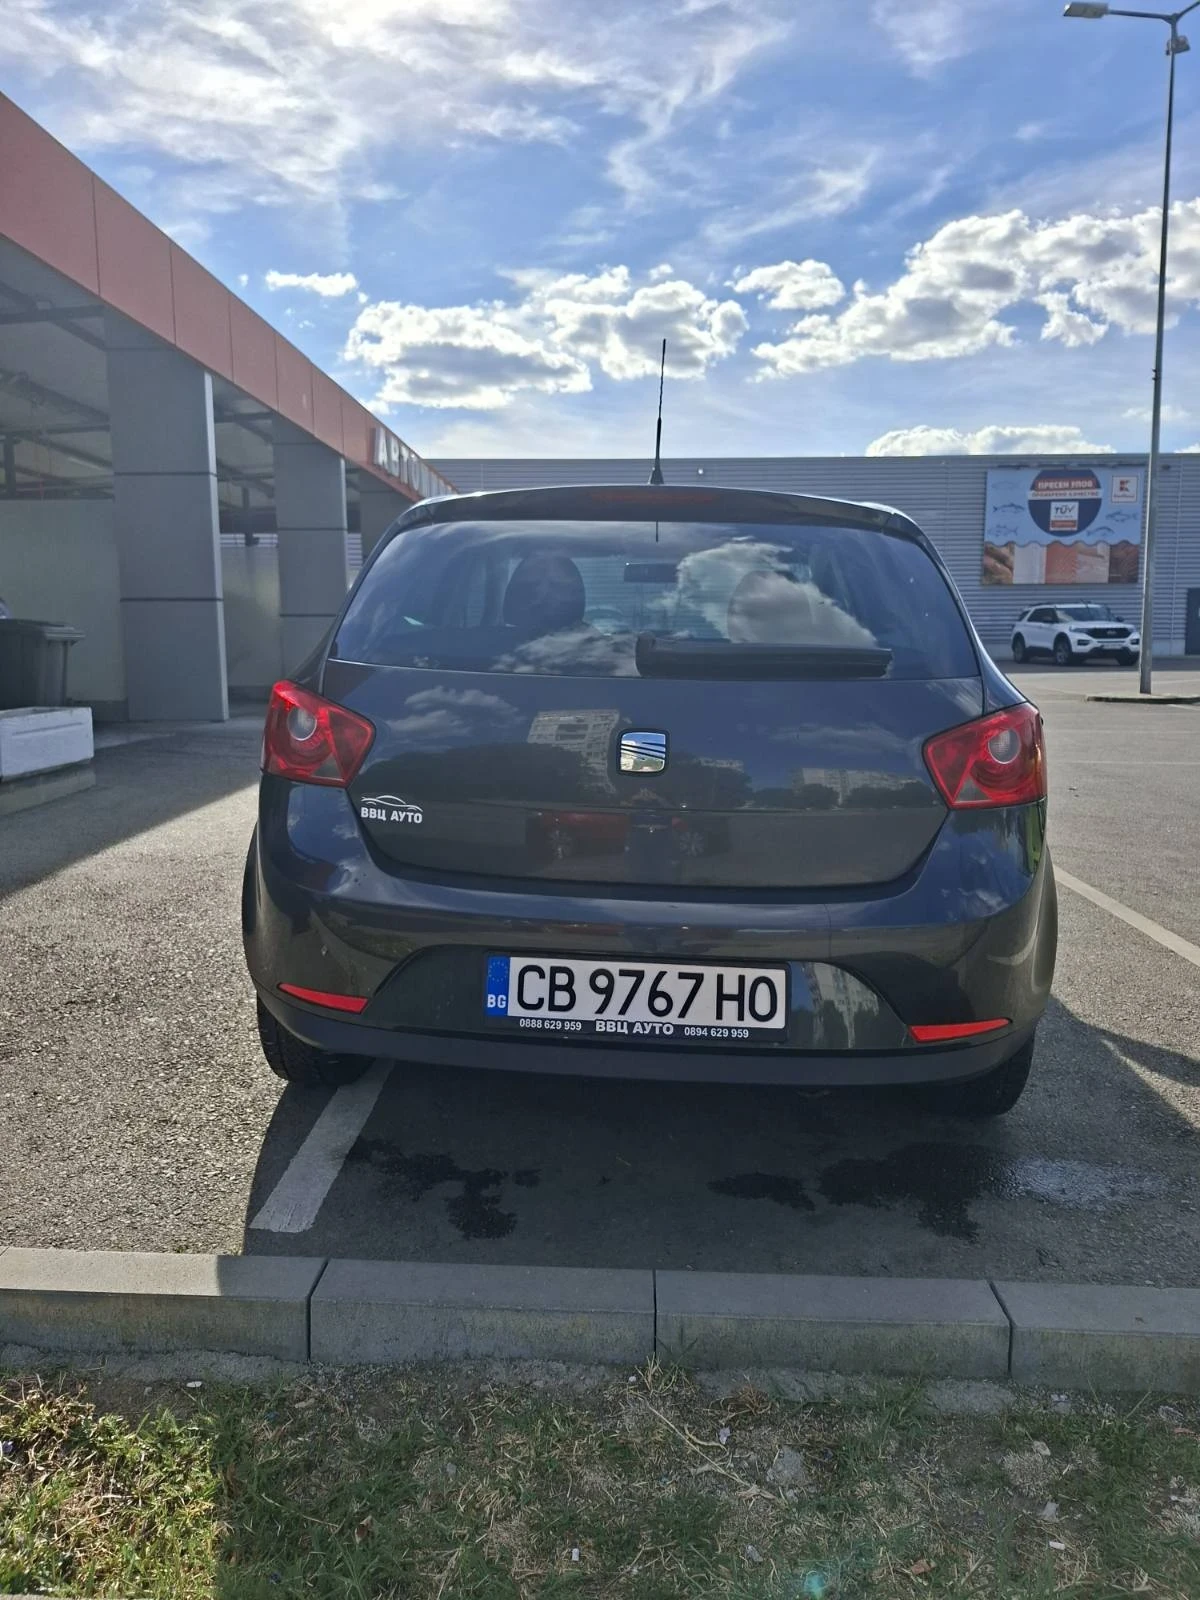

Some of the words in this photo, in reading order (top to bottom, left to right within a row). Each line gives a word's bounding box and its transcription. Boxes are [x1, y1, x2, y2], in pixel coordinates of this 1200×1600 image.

[1038, 480, 1069, 489] ПРЕСЕН
[1054, 504, 1076, 514] TÜV
[360, 807, 386, 821] ВВЦ
[390, 810, 423, 824] АУТО
[516, 964, 577, 1013] CB
[588, 968, 704, 1019] 9767
[715, 973, 778, 1022] HO
[487, 993, 507, 1009] BG
[519, 1018, 543, 1029] 0888
[544, 1019, 562, 1030] 629
[564, 1020, 582, 1031] 959
[595, 1020, 629, 1035] ВВЦ
[632, 1022, 674, 1036] АУТО
[684, 1026, 708, 1037] 0894
[711, 1027, 729, 1038] 629
[731, 1028, 749, 1039] 959
